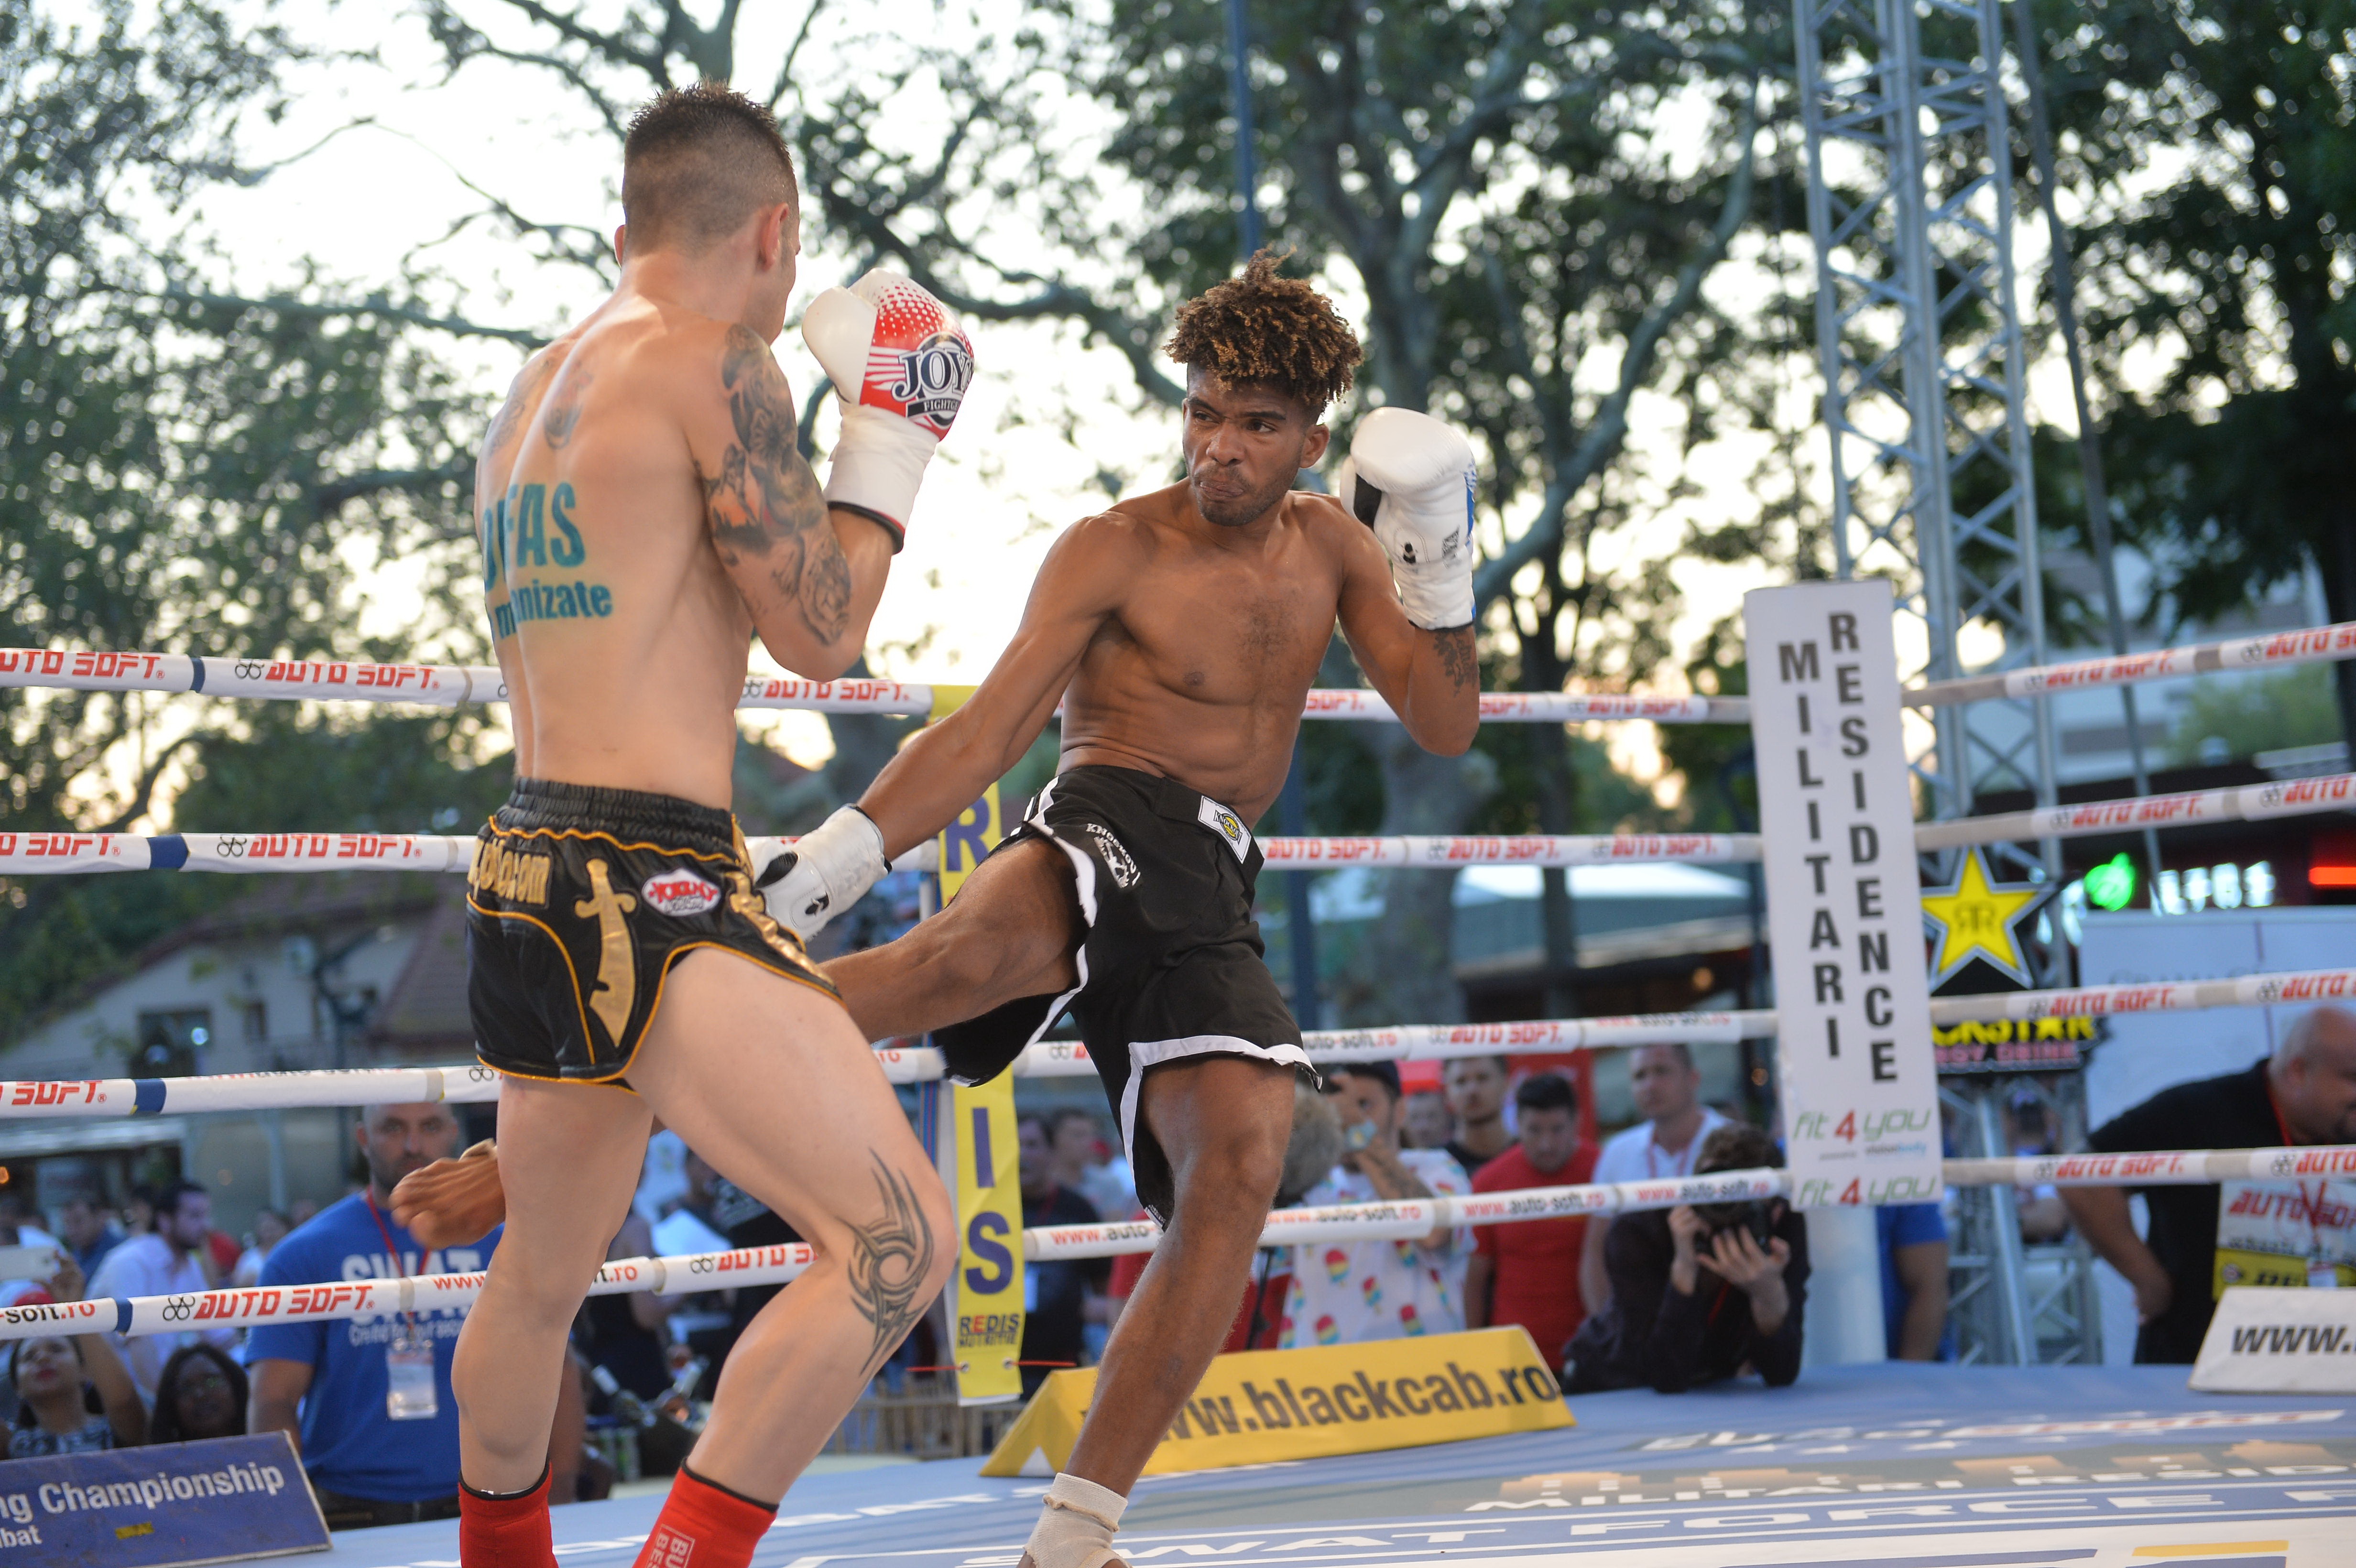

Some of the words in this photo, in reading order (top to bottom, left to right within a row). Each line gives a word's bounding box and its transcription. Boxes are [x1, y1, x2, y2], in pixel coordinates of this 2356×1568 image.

[72, 653, 161, 679] SOFT
[265, 662, 348, 684] AUTO
[356, 665, 435, 689] SOFT
[764, 679, 832, 699] AUTO
[839, 679, 903, 701] SOFT
[2285, 774, 2349, 805] AUTO
[2072, 801, 2134, 828] AUTO
[2137, 794, 2201, 822] SOFT
[25, 833, 115, 856] SOFT
[248, 833, 329, 857] AUTO
[337, 833, 415, 858] SOFT
[1266, 838, 1323, 860] AUTO
[1778, 641, 1844, 1058] MILITARI
[1828, 611, 1898, 1084] RESIDENCE
[2281, 974, 2348, 1001] AUTO
[2050, 994, 2105, 1018] AUTO
[2112, 987, 2175, 1013] SOFT
[11, 1080, 102, 1105] SOFT
[1834, 1108, 1857, 1144] 4
[2056, 1157, 2115, 1178] AUTO
[2119, 1153, 2184, 1176] SOFT
[1839, 1176, 1862, 1207] 4
[193, 1290, 282, 1320] AUTO
[287, 1285, 373, 1314] SOFT
[959, 1314, 1019, 1337] REDIS
[2231, 1326, 2356, 1354] www.
[39, 1461, 285, 1514] Championship
[2010, 1465, 2356, 1486] RESID
[1570, 1494, 2226, 1536] FORCE
[0, 1524, 43, 1549] bat
